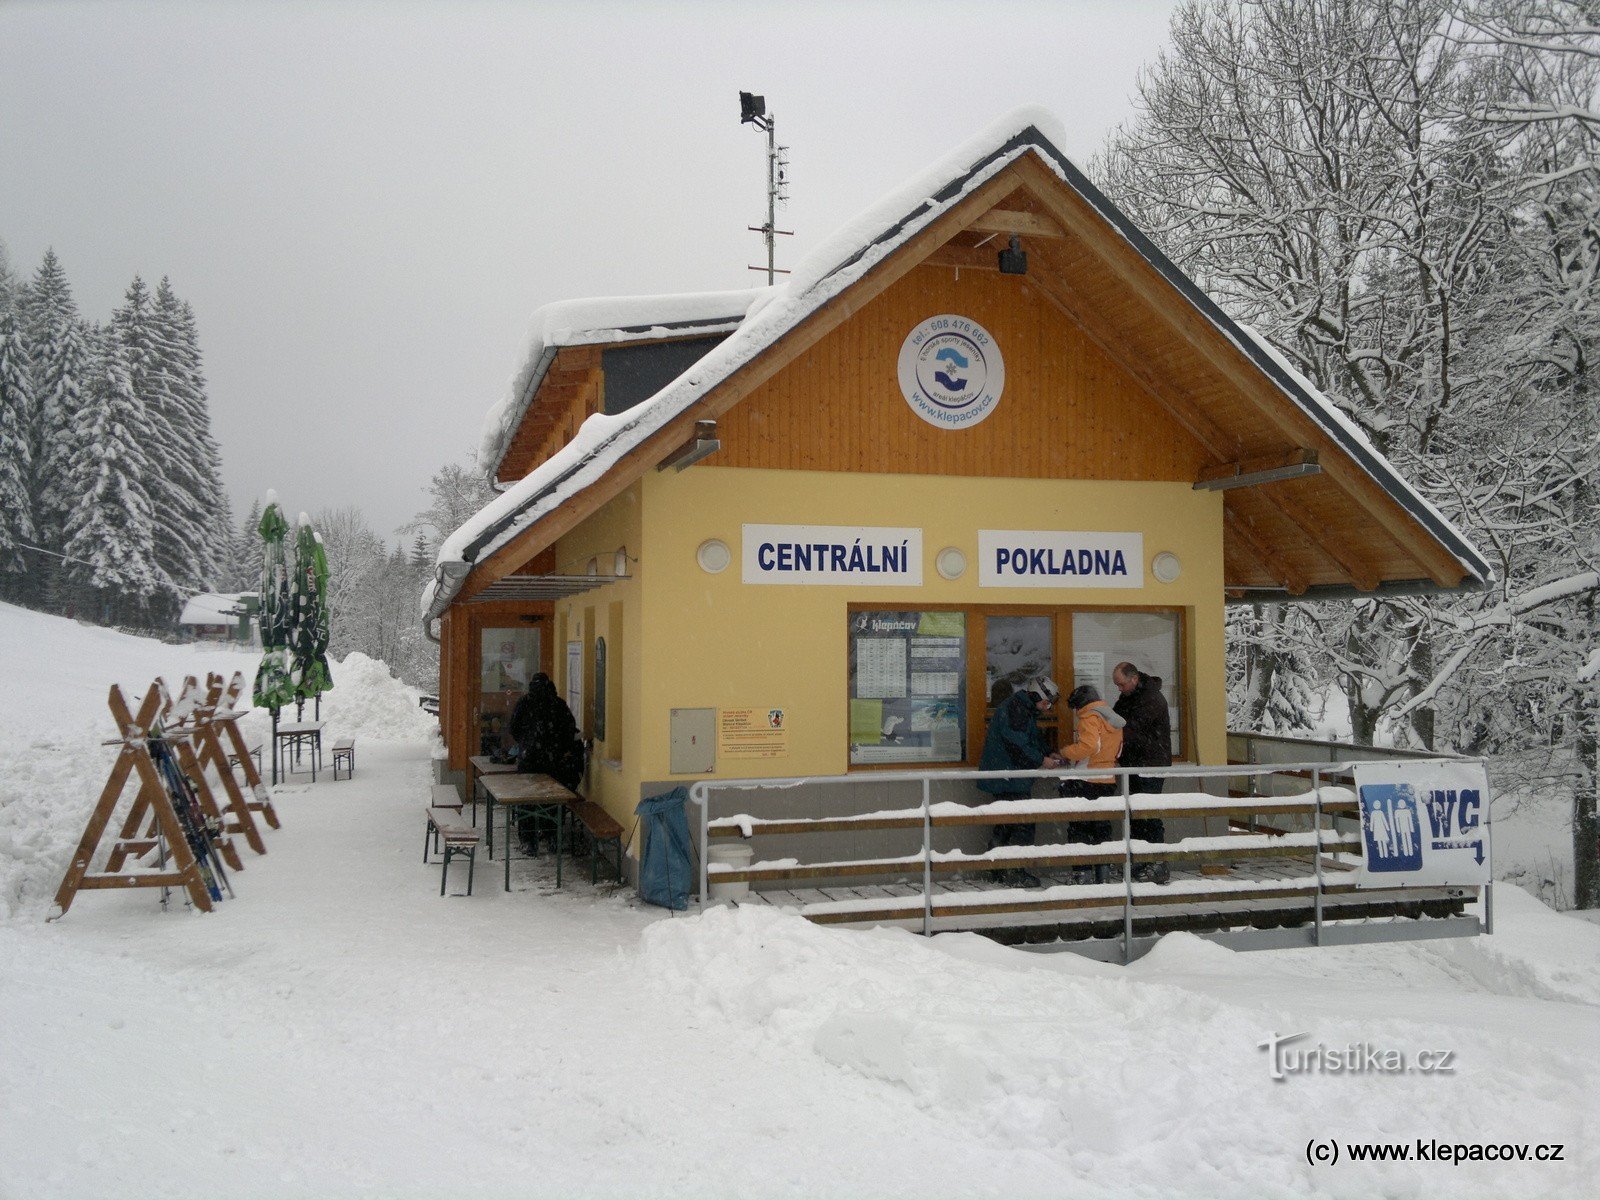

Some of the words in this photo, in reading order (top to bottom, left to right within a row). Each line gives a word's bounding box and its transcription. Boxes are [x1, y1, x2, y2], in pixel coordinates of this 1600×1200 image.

[912, 328, 930, 346] tel.:
[931, 320, 949, 331] 608
[952, 320, 970, 332] 476
[972, 328, 989, 346] 662
[941, 337, 961, 345] sporty
[912, 392, 993, 424] www.klepacov.cz
[757, 538, 908, 573] CENTRÁLNÍ
[995, 547, 1128, 576] POKLADNA
[1421, 788, 1480, 838] WC
